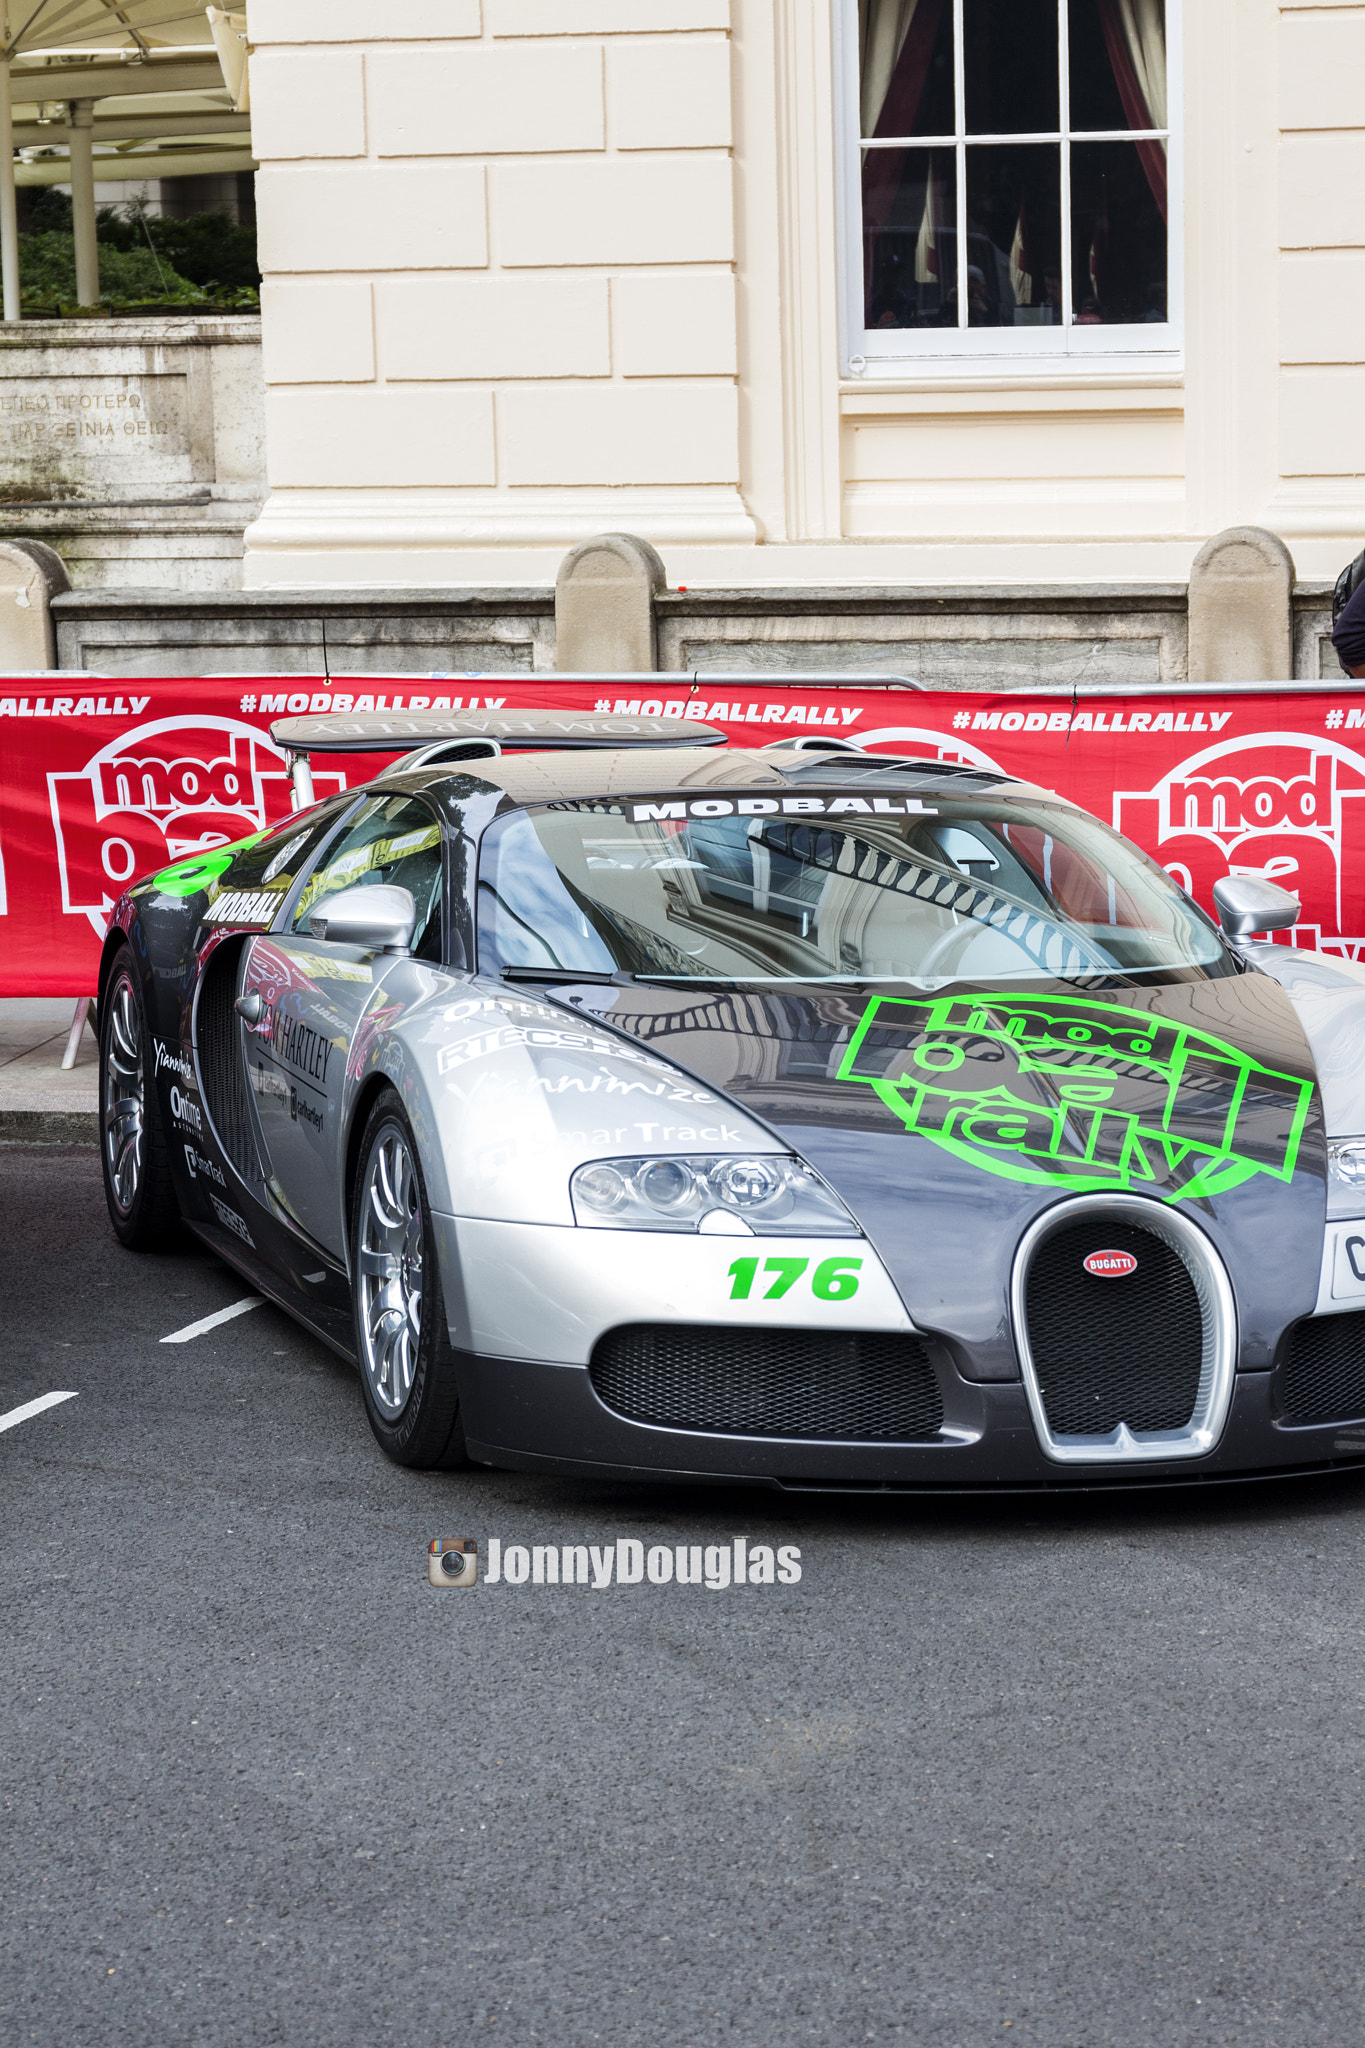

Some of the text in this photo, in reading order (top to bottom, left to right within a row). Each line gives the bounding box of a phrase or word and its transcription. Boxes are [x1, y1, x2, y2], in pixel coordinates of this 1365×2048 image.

[55, 394, 141, 410] ΠΡΟΤΕΡΩ
[53, 421, 116, 438] ΞΕΙΝΙΑ
[123, 420, 169, 436] ΘΕΙΩ
[239, 693, 507, 713] #MODBALLRALLY
[593, 699, 864, 726] #MODBALLRALLY
[952, 711, 1234, 732] #MODBALLRALLY
[100, 732, 264, 810] mod
[1160, 750, 1338, 833] mod
[633, 797, 940, 822] MODBALL
[202, 892, 284, 923] MODBALL
[280, 1014, 334, 1084] HARTLEY
[925, 1000, 1184, 1069] mod
[905, 1086, 1245, 1204] rally
[727, 1256, 864, 1301] 176
[1089, 1258, 1132, 1270] BUGATTI
